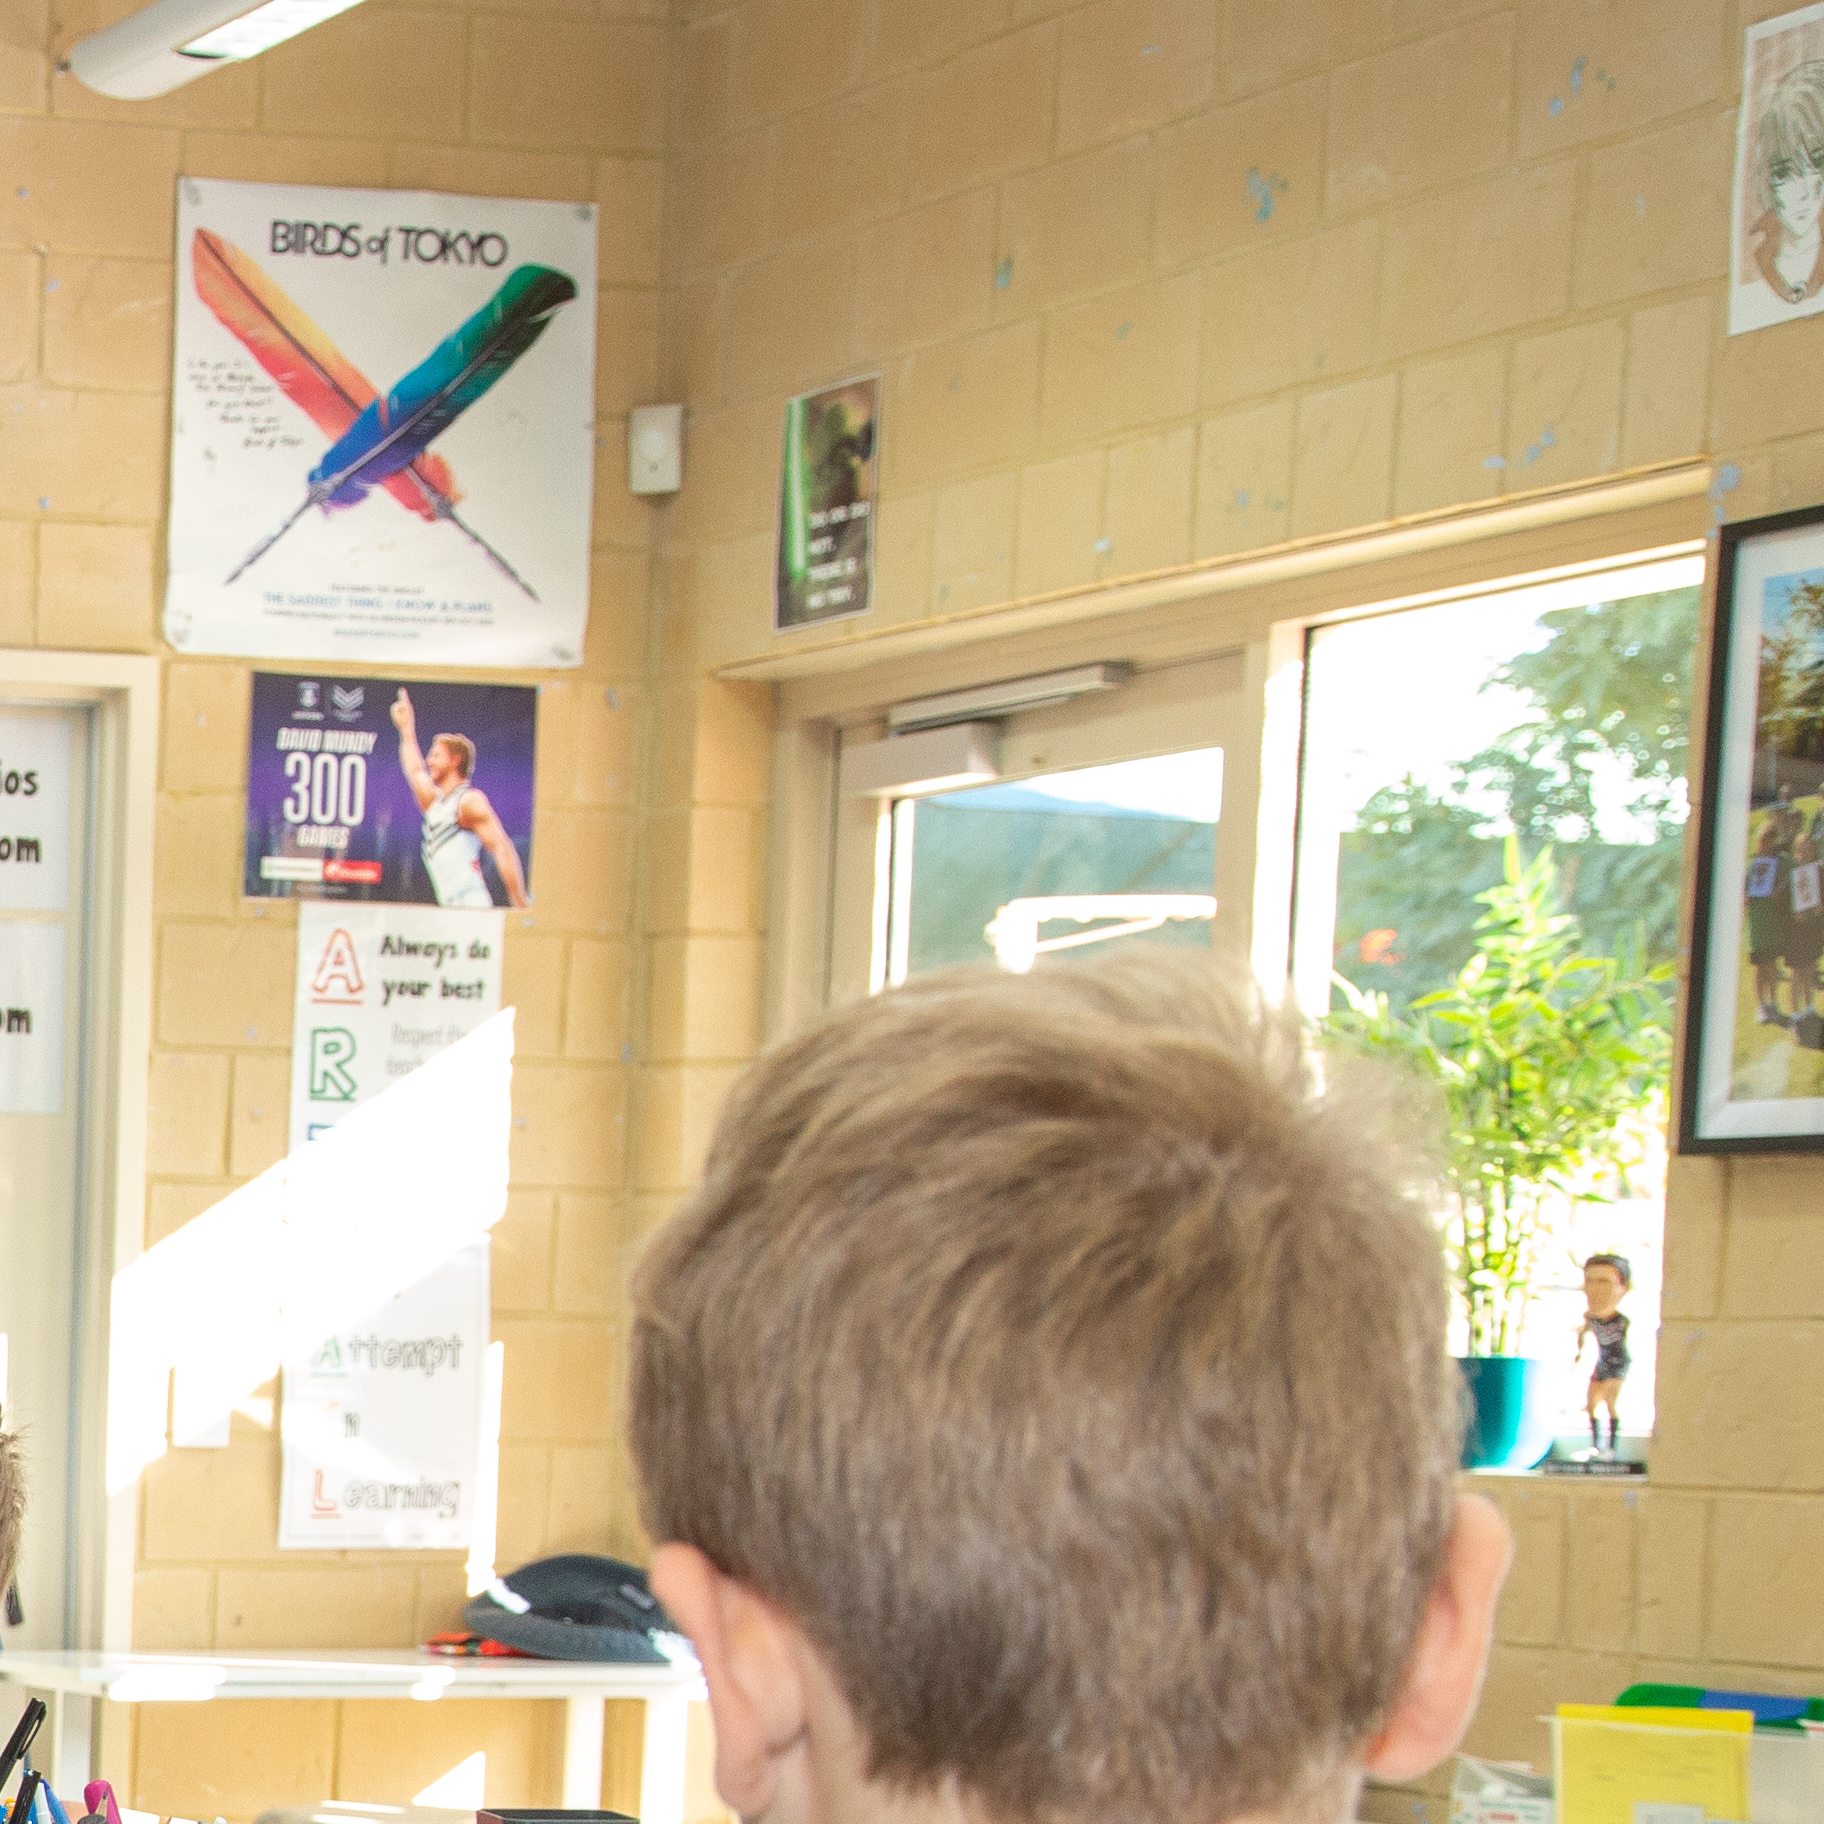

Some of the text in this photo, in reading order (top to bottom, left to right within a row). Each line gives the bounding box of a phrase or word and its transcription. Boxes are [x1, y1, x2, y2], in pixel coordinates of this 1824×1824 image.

[271, 219, 509, 268] BIRDS of TOKYO
[282, 751, 368, 827] 300
[379, 933, 492, 970] Always do
[381, 976, 486, 1008] your best
[311, 1468, 462, 1520] Learning
